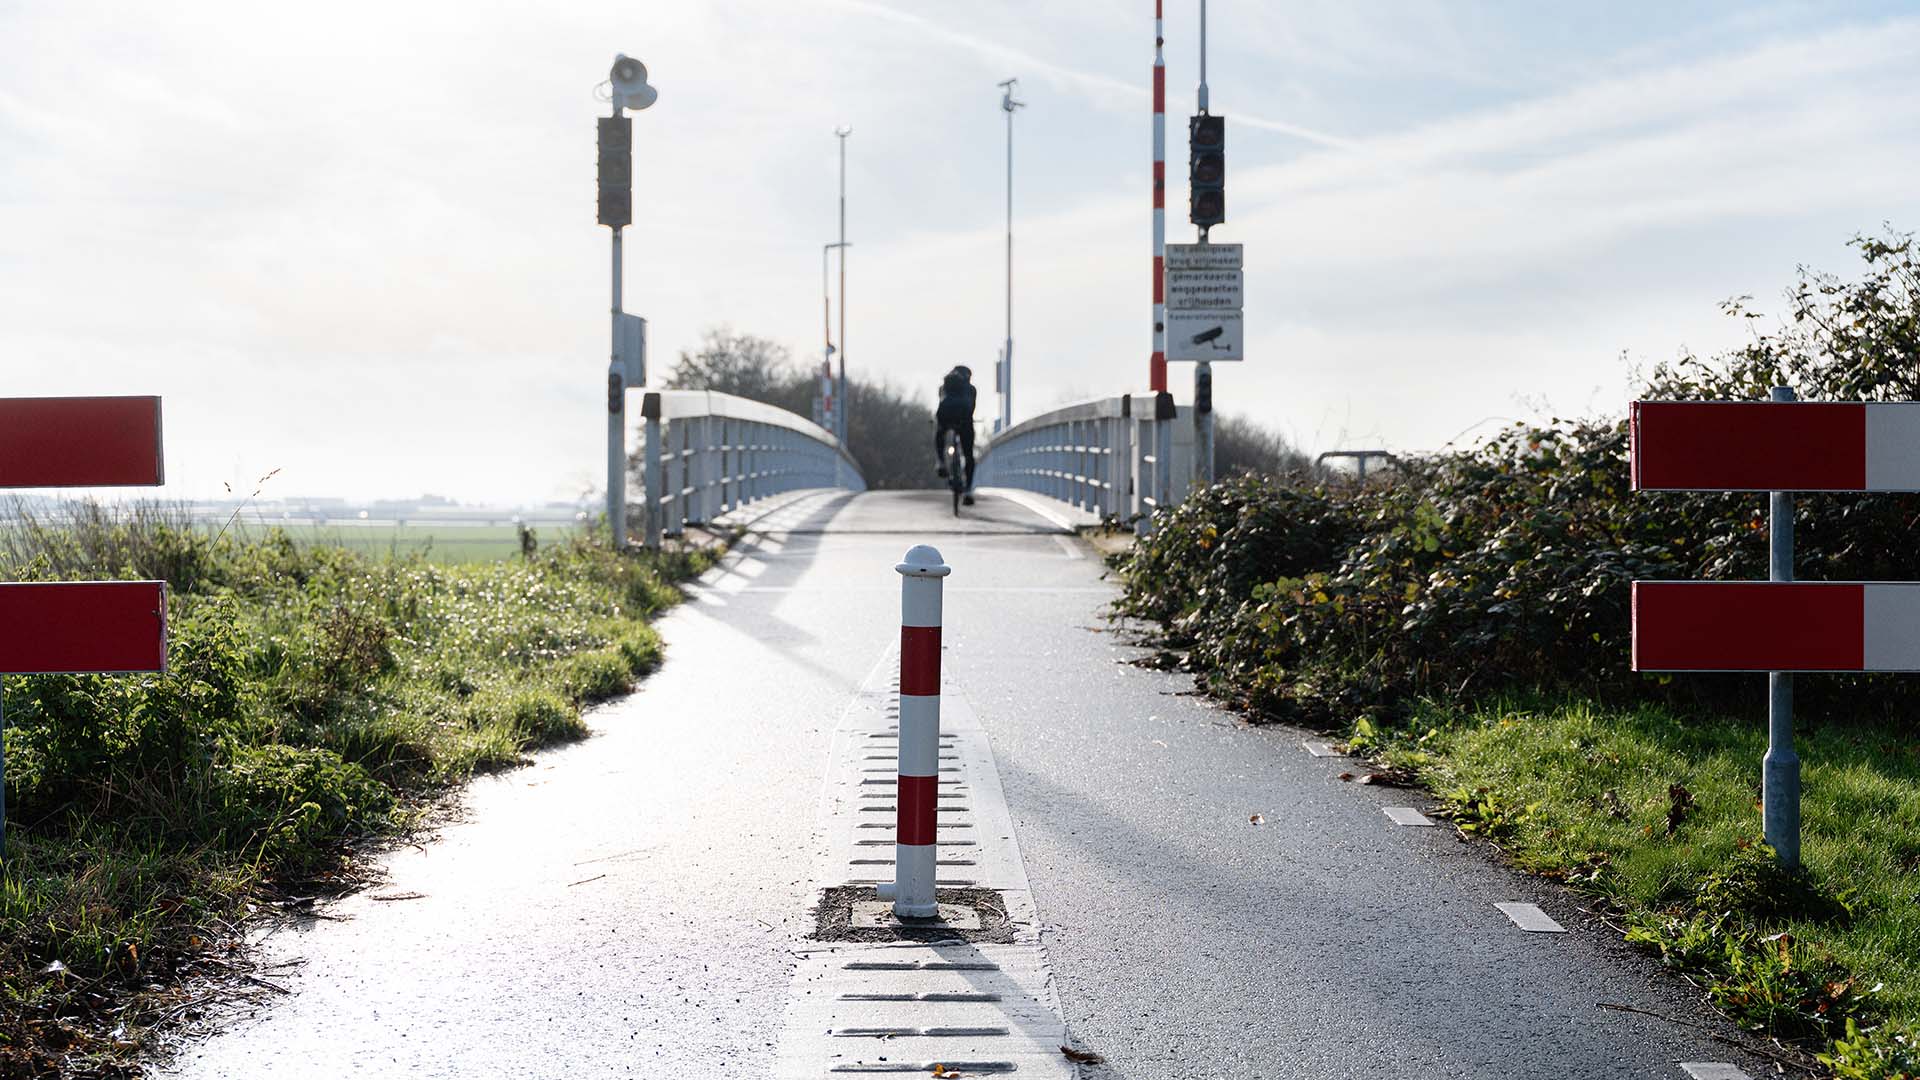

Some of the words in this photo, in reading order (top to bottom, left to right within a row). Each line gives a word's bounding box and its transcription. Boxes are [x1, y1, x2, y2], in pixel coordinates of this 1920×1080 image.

[1172, 272, 1237, 283] gemarkeerde
[1171, 286, 1238, 295] weggedeelten
[1177, 296, 1232, 306] vrijhouden
